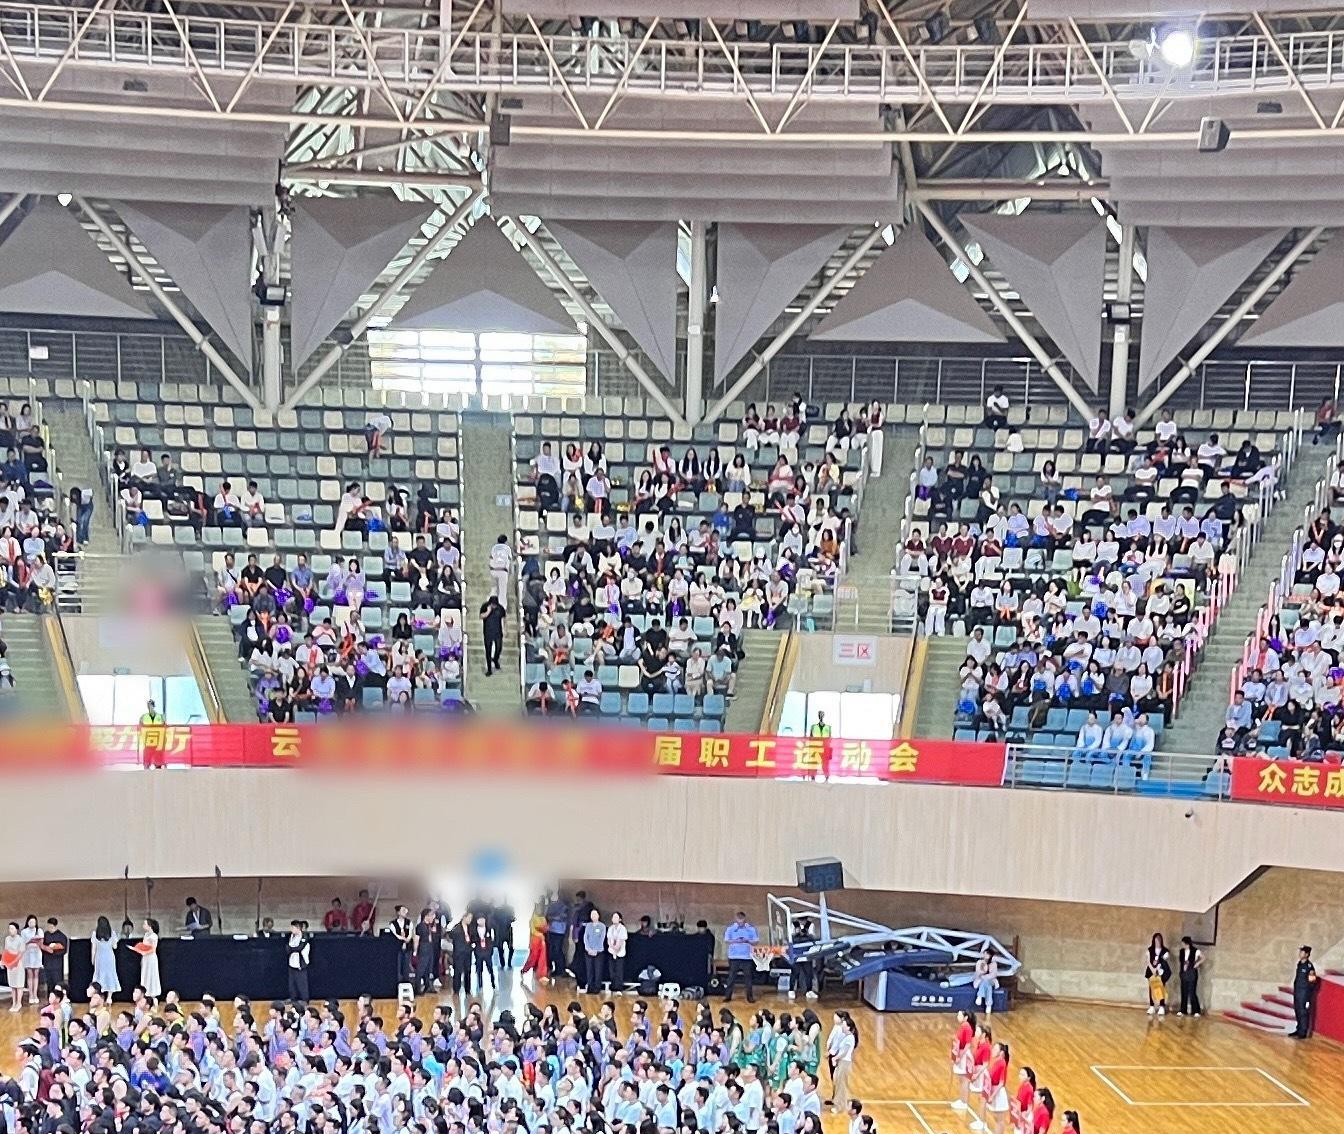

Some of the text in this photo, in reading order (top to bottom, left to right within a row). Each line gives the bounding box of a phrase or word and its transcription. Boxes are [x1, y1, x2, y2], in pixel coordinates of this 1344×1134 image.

[838, 642, 872, 660] 三区
[652, 735, 919, 773] 届职工运动会
